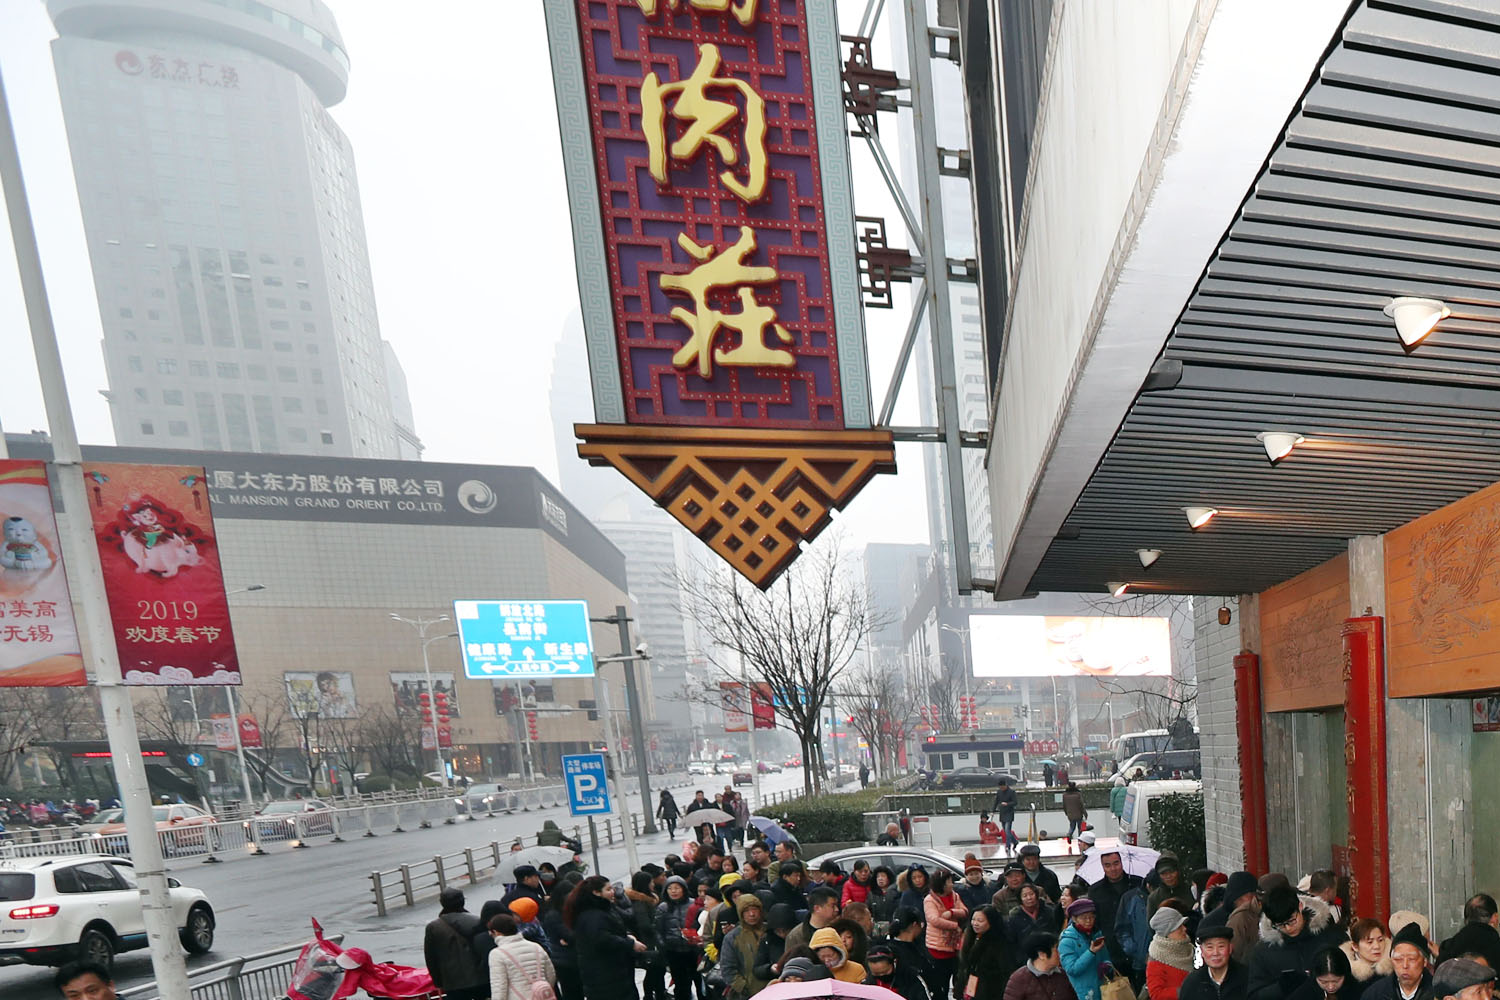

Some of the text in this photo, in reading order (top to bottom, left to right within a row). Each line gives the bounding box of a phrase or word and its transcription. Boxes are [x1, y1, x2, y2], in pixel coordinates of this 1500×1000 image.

[230, 494, 289, 507] MANSION
[295, 498, 340, 509] GRAND
[346, 500, 391, 511] ORIENT
[137, 600, 199, 621] 2019
[0, 625, 54, 643] 无锡
[125, 626, 222, 644] 欢度春节
[574, 774, 597, 801] P
